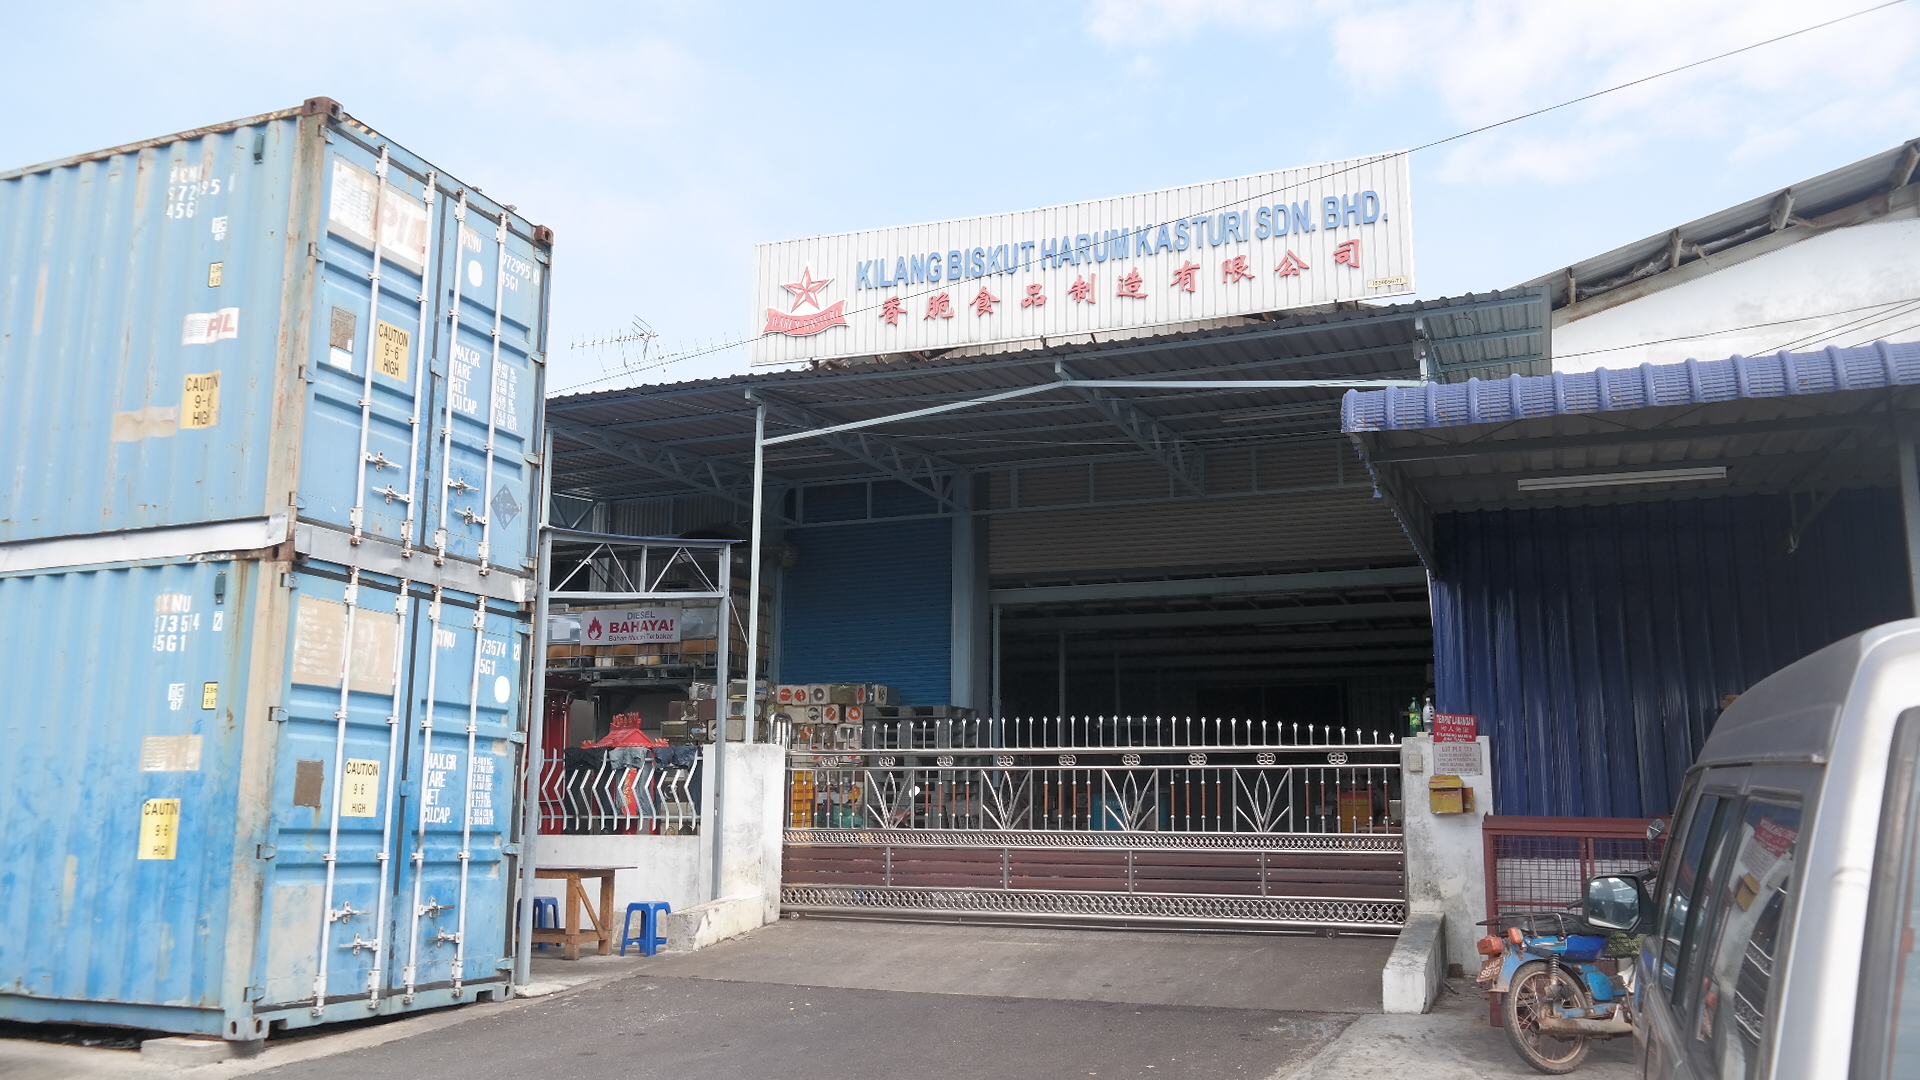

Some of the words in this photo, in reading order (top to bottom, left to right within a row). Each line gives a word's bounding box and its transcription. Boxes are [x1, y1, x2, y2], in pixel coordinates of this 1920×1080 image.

[857, 251, 942, 291] KILANG
[948, 241, 1035, 281] BISKUT
[1041, 228, 1130, 270] HARUM
[1136, 211, 1248, 258] KASTURI
[1255, 200, 1316, 240] SDN.
[1323, 190, 1389, 230] BHD.
[879, 239, 1360, 325] 香脆食品制造有限公司
[378, 323, 409, 347] CAUTION
[383, 357, 399, 376] HIGH
[454, 361, 472, 381] TARE
[627, 610, 656, 620] DIESEL
[609, 619, 674, 634] BAHAYA!
[482, 638, 507, 658] 73574
[480, 658, 496, 676] 5G1
[346, 762, 379, 776] CAUTION
[351, 803, 366, 814] HIGH
